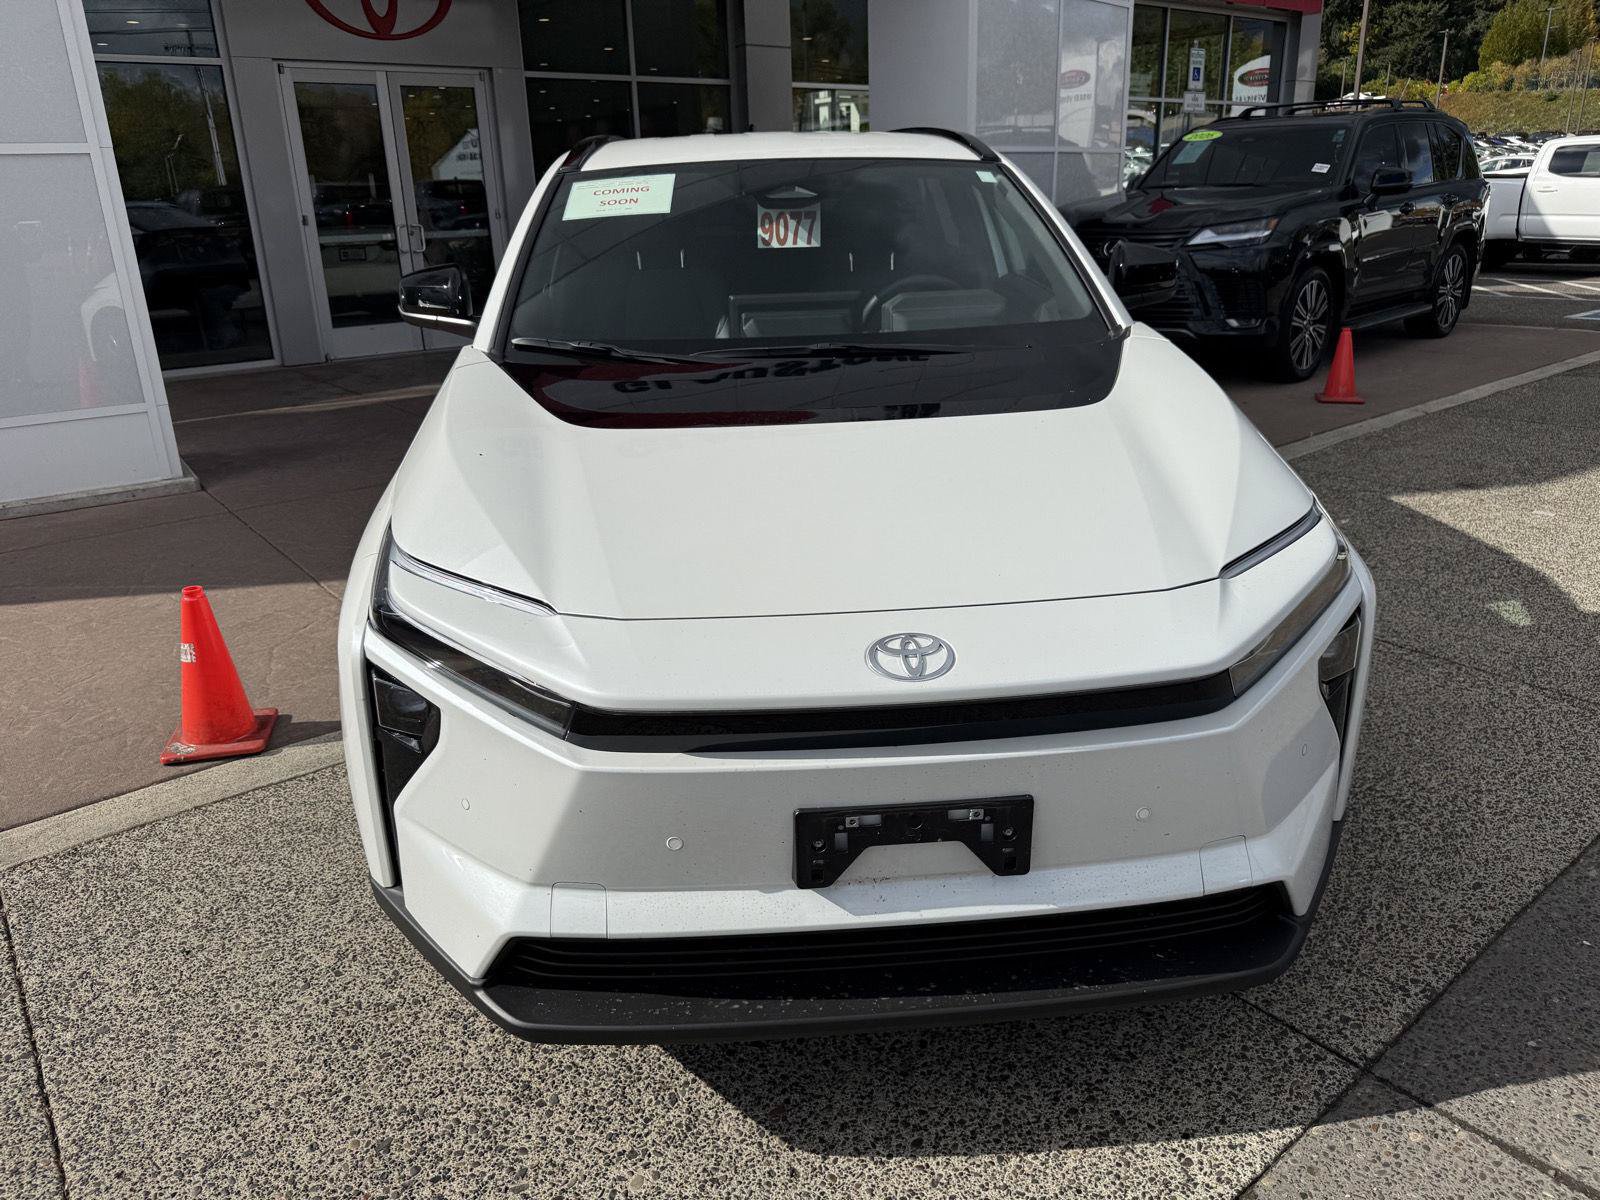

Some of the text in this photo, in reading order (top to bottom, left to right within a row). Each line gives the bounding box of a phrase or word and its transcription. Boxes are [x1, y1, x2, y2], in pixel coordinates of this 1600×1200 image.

[593, 185, 651, 196] COMING
[599, 198, 639, 207] SOON
[760, 210, 817, 247] 9077
